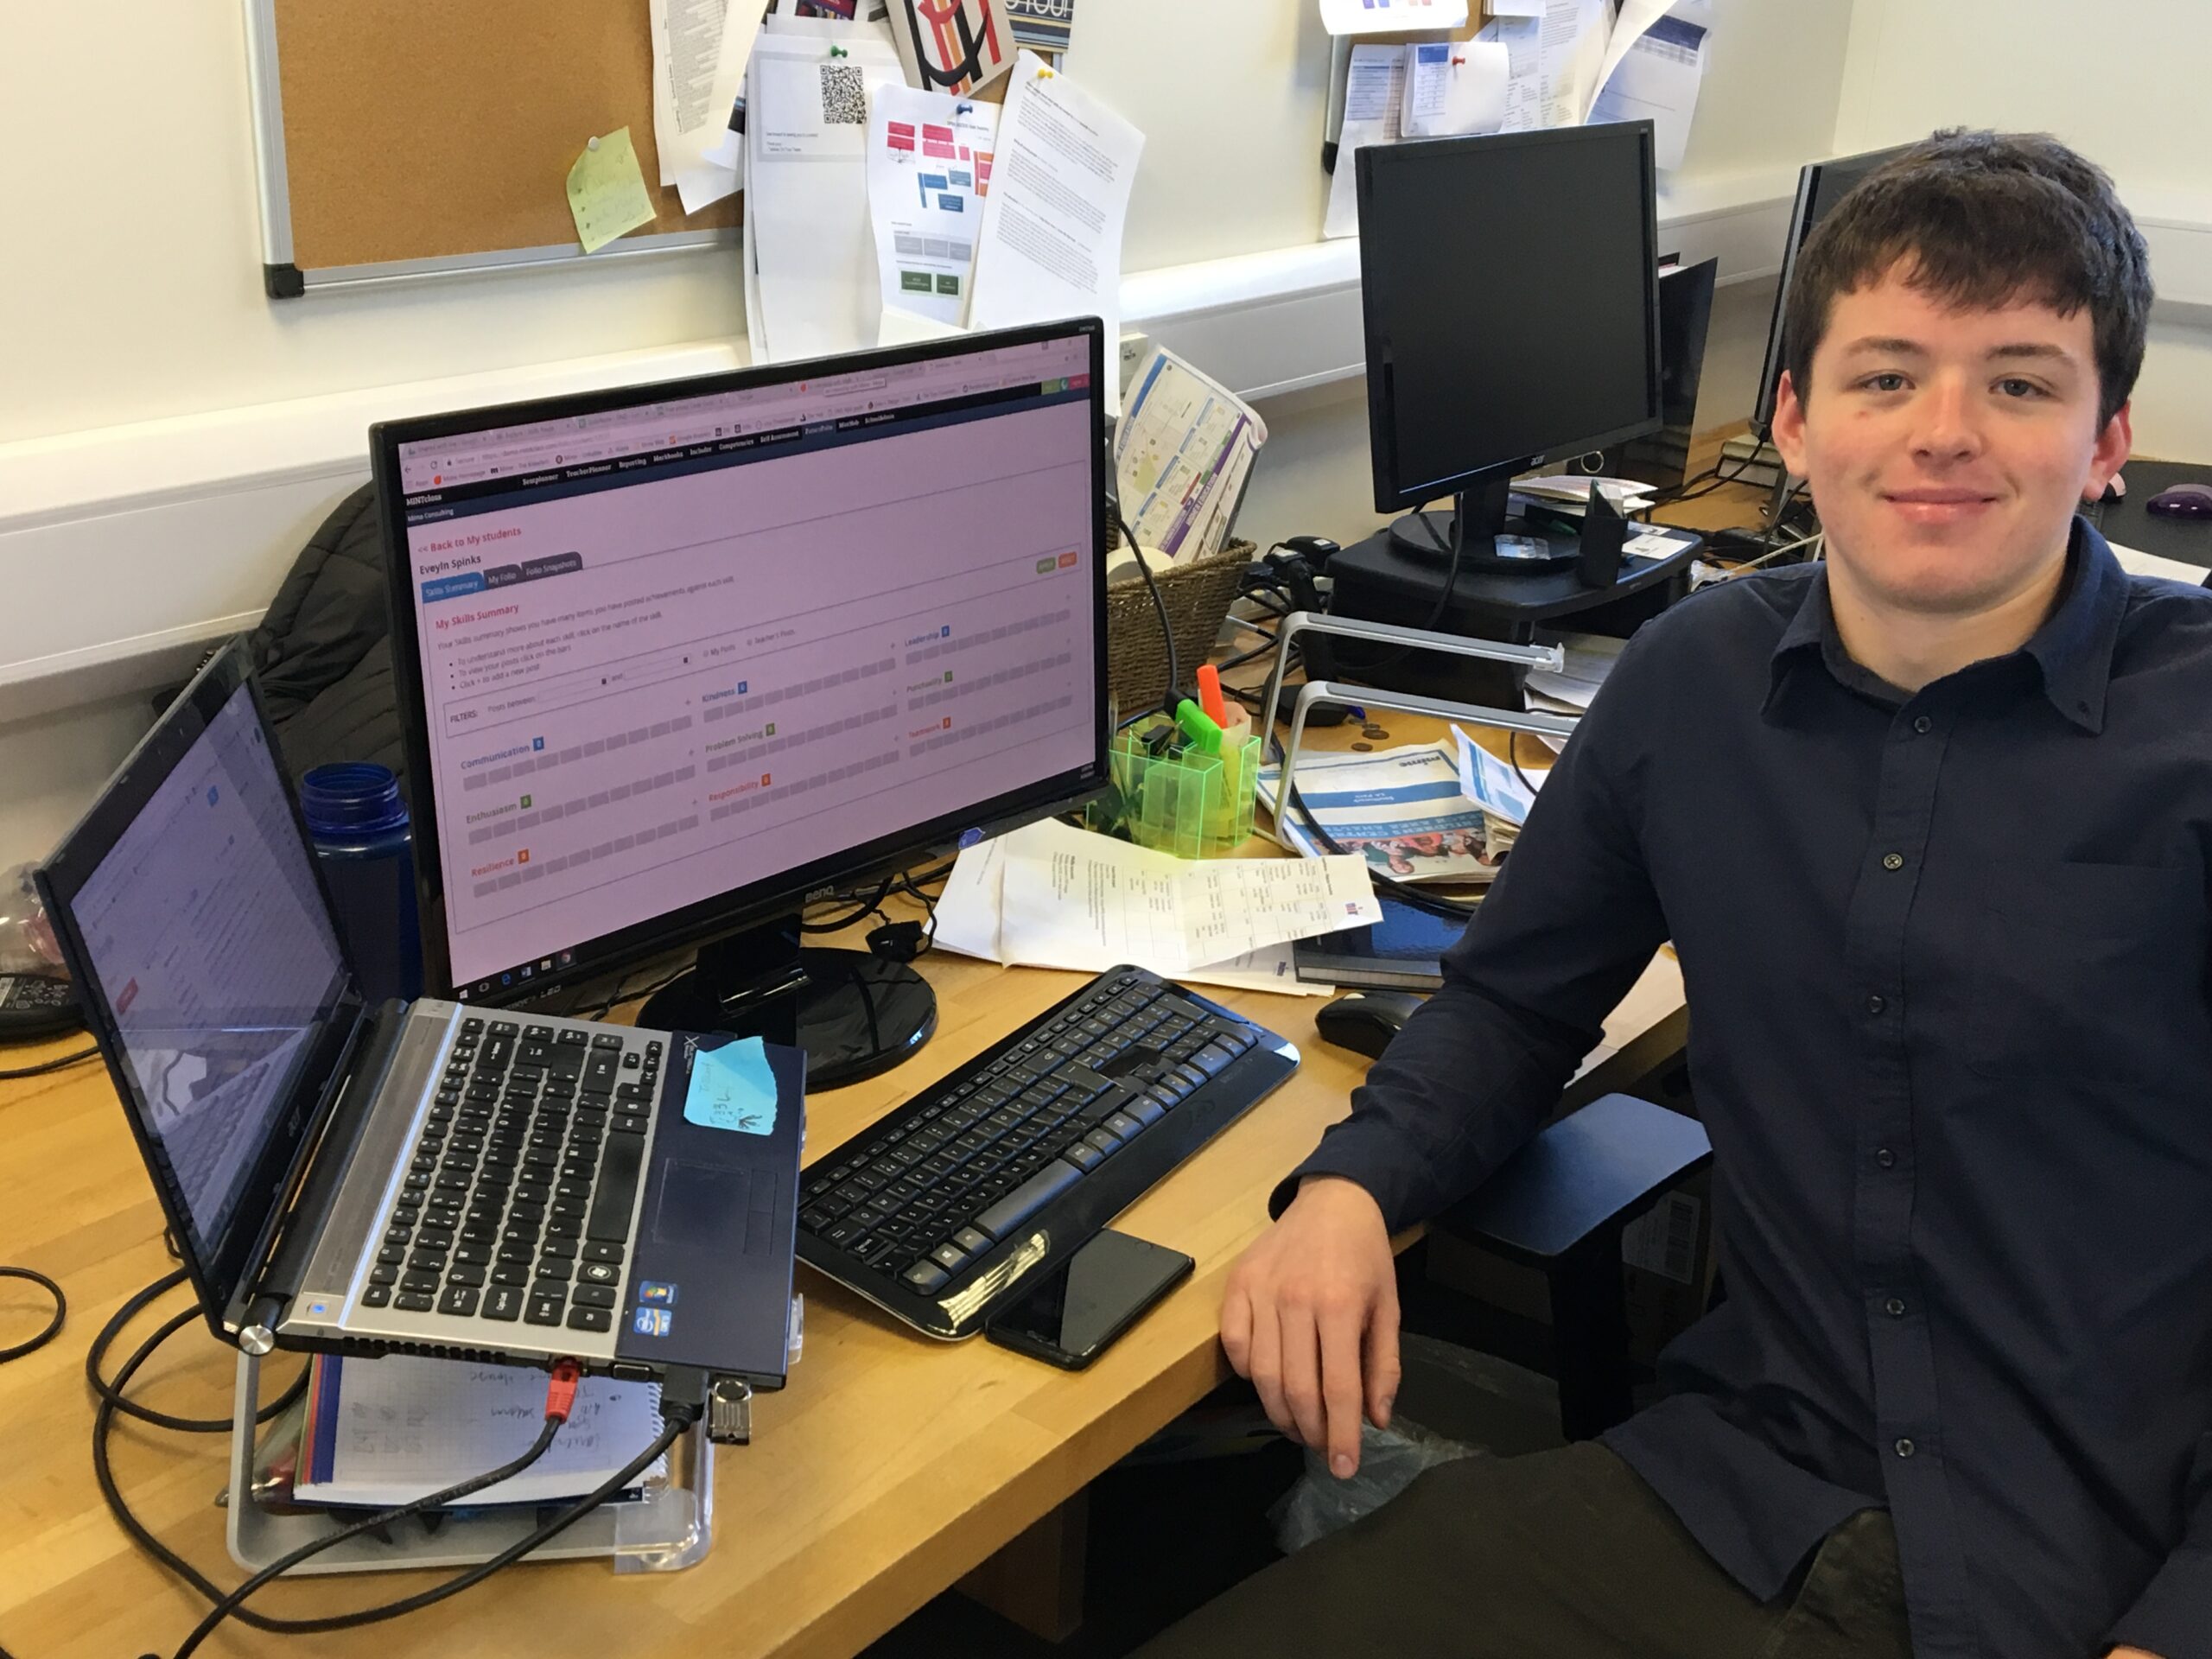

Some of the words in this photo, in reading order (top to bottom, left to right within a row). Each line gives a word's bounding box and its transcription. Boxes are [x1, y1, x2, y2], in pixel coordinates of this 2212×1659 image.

[619, 457, 647, 469] Reporting
[430, 539, 453, 552] Back
[455, 537, 465, 547] to
[467, 535, 480, 547] My
[482, 526, 522, 542] students
[451, 554, 481, 569] Spinks
[525, 567, 542, 576] Folio
[543, 560, 577, 573] Snapshots
[488, 575, 499, 585] My
[499, 572, 517, 581] Folio
[426, 587, 444, 597] Skills
[445, 582, 479, 594] Summary
[435, 619, 449, 630] My
[451, 613, 475, 626] Skills
[476, 605, 519, 620] Summary
[473, 630, 505, 643] summary
[505, 624, 527, 636] shows
[528, 620, 540, 631] you
[541, 616, 556, 626] have
[557, 613, 575, 622] many
[576, 608, 594, 618] items
[594, 606, 607, 615] you
[607, 602, 623, 611] have
[623, 596, 645, 607] posted
[645, 588, 685, 602] achievements
[708, 579, 721, 588] each
[467, 649, 505, 664] understand
[507, 645, 524, 654] more
[525, 639, 544, 650] about
[546, 636, 562, 645] each
[601, 623, 612, 632] the
[613, 619, 630, 630] name
[639, 614, 649, 623] the
[468, 665, 483, 675] view
[485, 662, 499, 673] your
[501, 658, 519, 669] posts
[545, 648, 556, 657] the
[557, 644, 571, 654] bars
[460, 679, 475, 690] Click
[492, 671, 504, 681] add
[511, 668, 524, 677] new
[525, 664, 540, 675] post
[487, 702, 505, 713] Posts
[507, 696, 536, 709] between
[702, 689, 735, 702] Kindness
[705, 739, 736, 753] Problem
[737, 731, 764, 743] Solving
[461, 745, 530, 769] Communication
[1399, 755, 1441, 767] mime
[709, 781, 759, 802] Responsibility
[466, 804, 517, 823] Enthusiasm
[471, 858, 514, 877] Resilience
